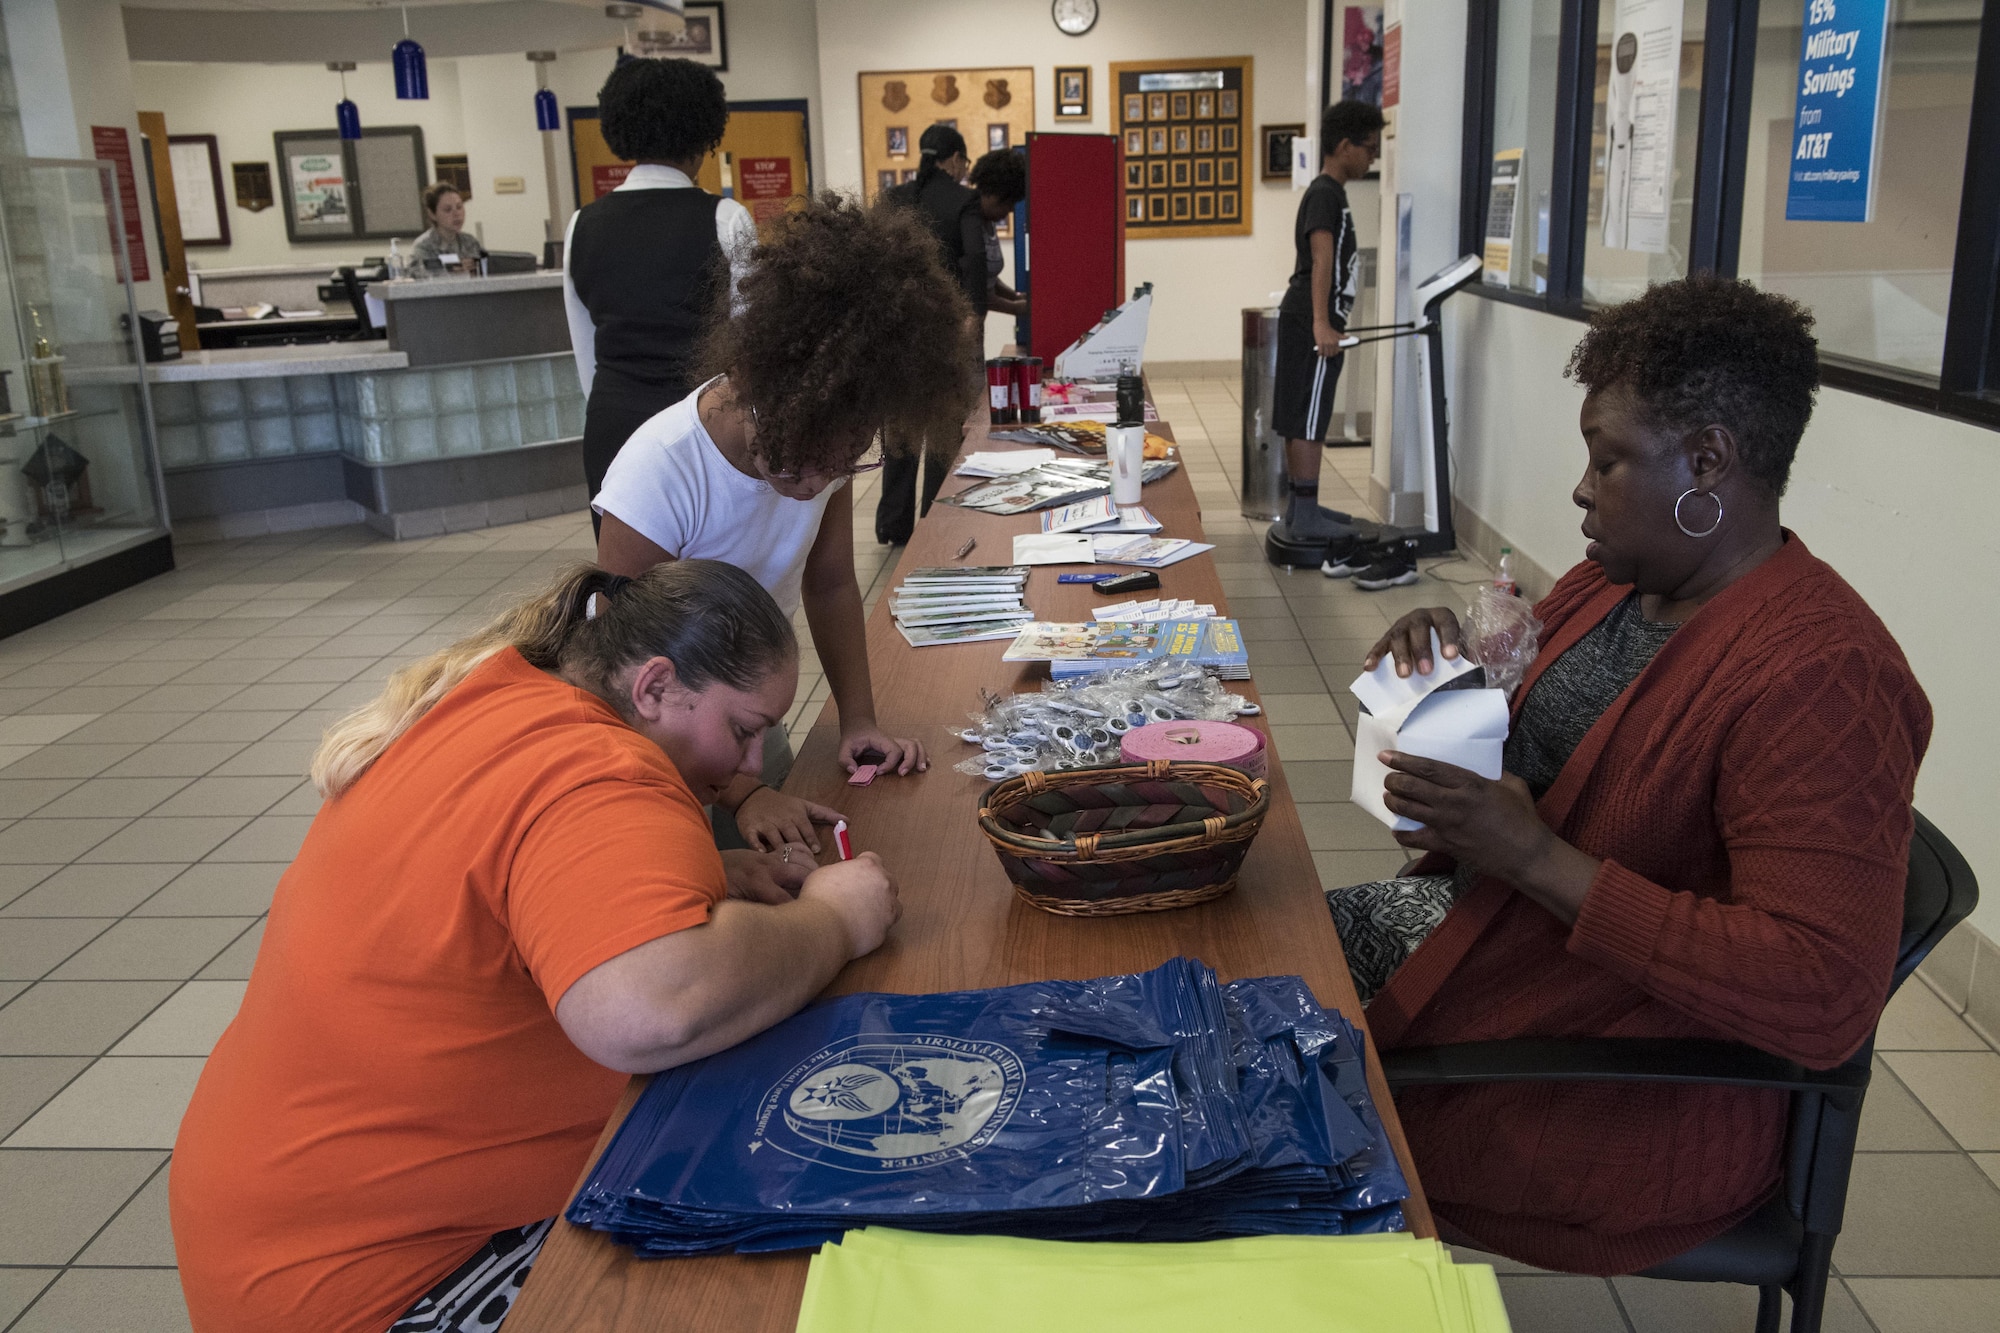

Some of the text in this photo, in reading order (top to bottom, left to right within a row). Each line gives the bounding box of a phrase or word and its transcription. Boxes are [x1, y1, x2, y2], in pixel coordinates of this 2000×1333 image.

[1809, 0, 1836, 26] 15%
[1805, 28, 1860, 61] Military
[1802, 64, 1856, 98] Savings
[1799, 105, 1822, 128] from
[1795, 132, 1833, 160] AT&T
[754, 161, 776, 171] STOP
[1177, 623, 1188, 633] IS
[1187, 623, 1199, 635] MY
[912, 1036, 980, 1053] AIRMAN
[754, 1049, 833, 1136] The Total Force Resource
[881, 1147, 967, 1168] CENTER
